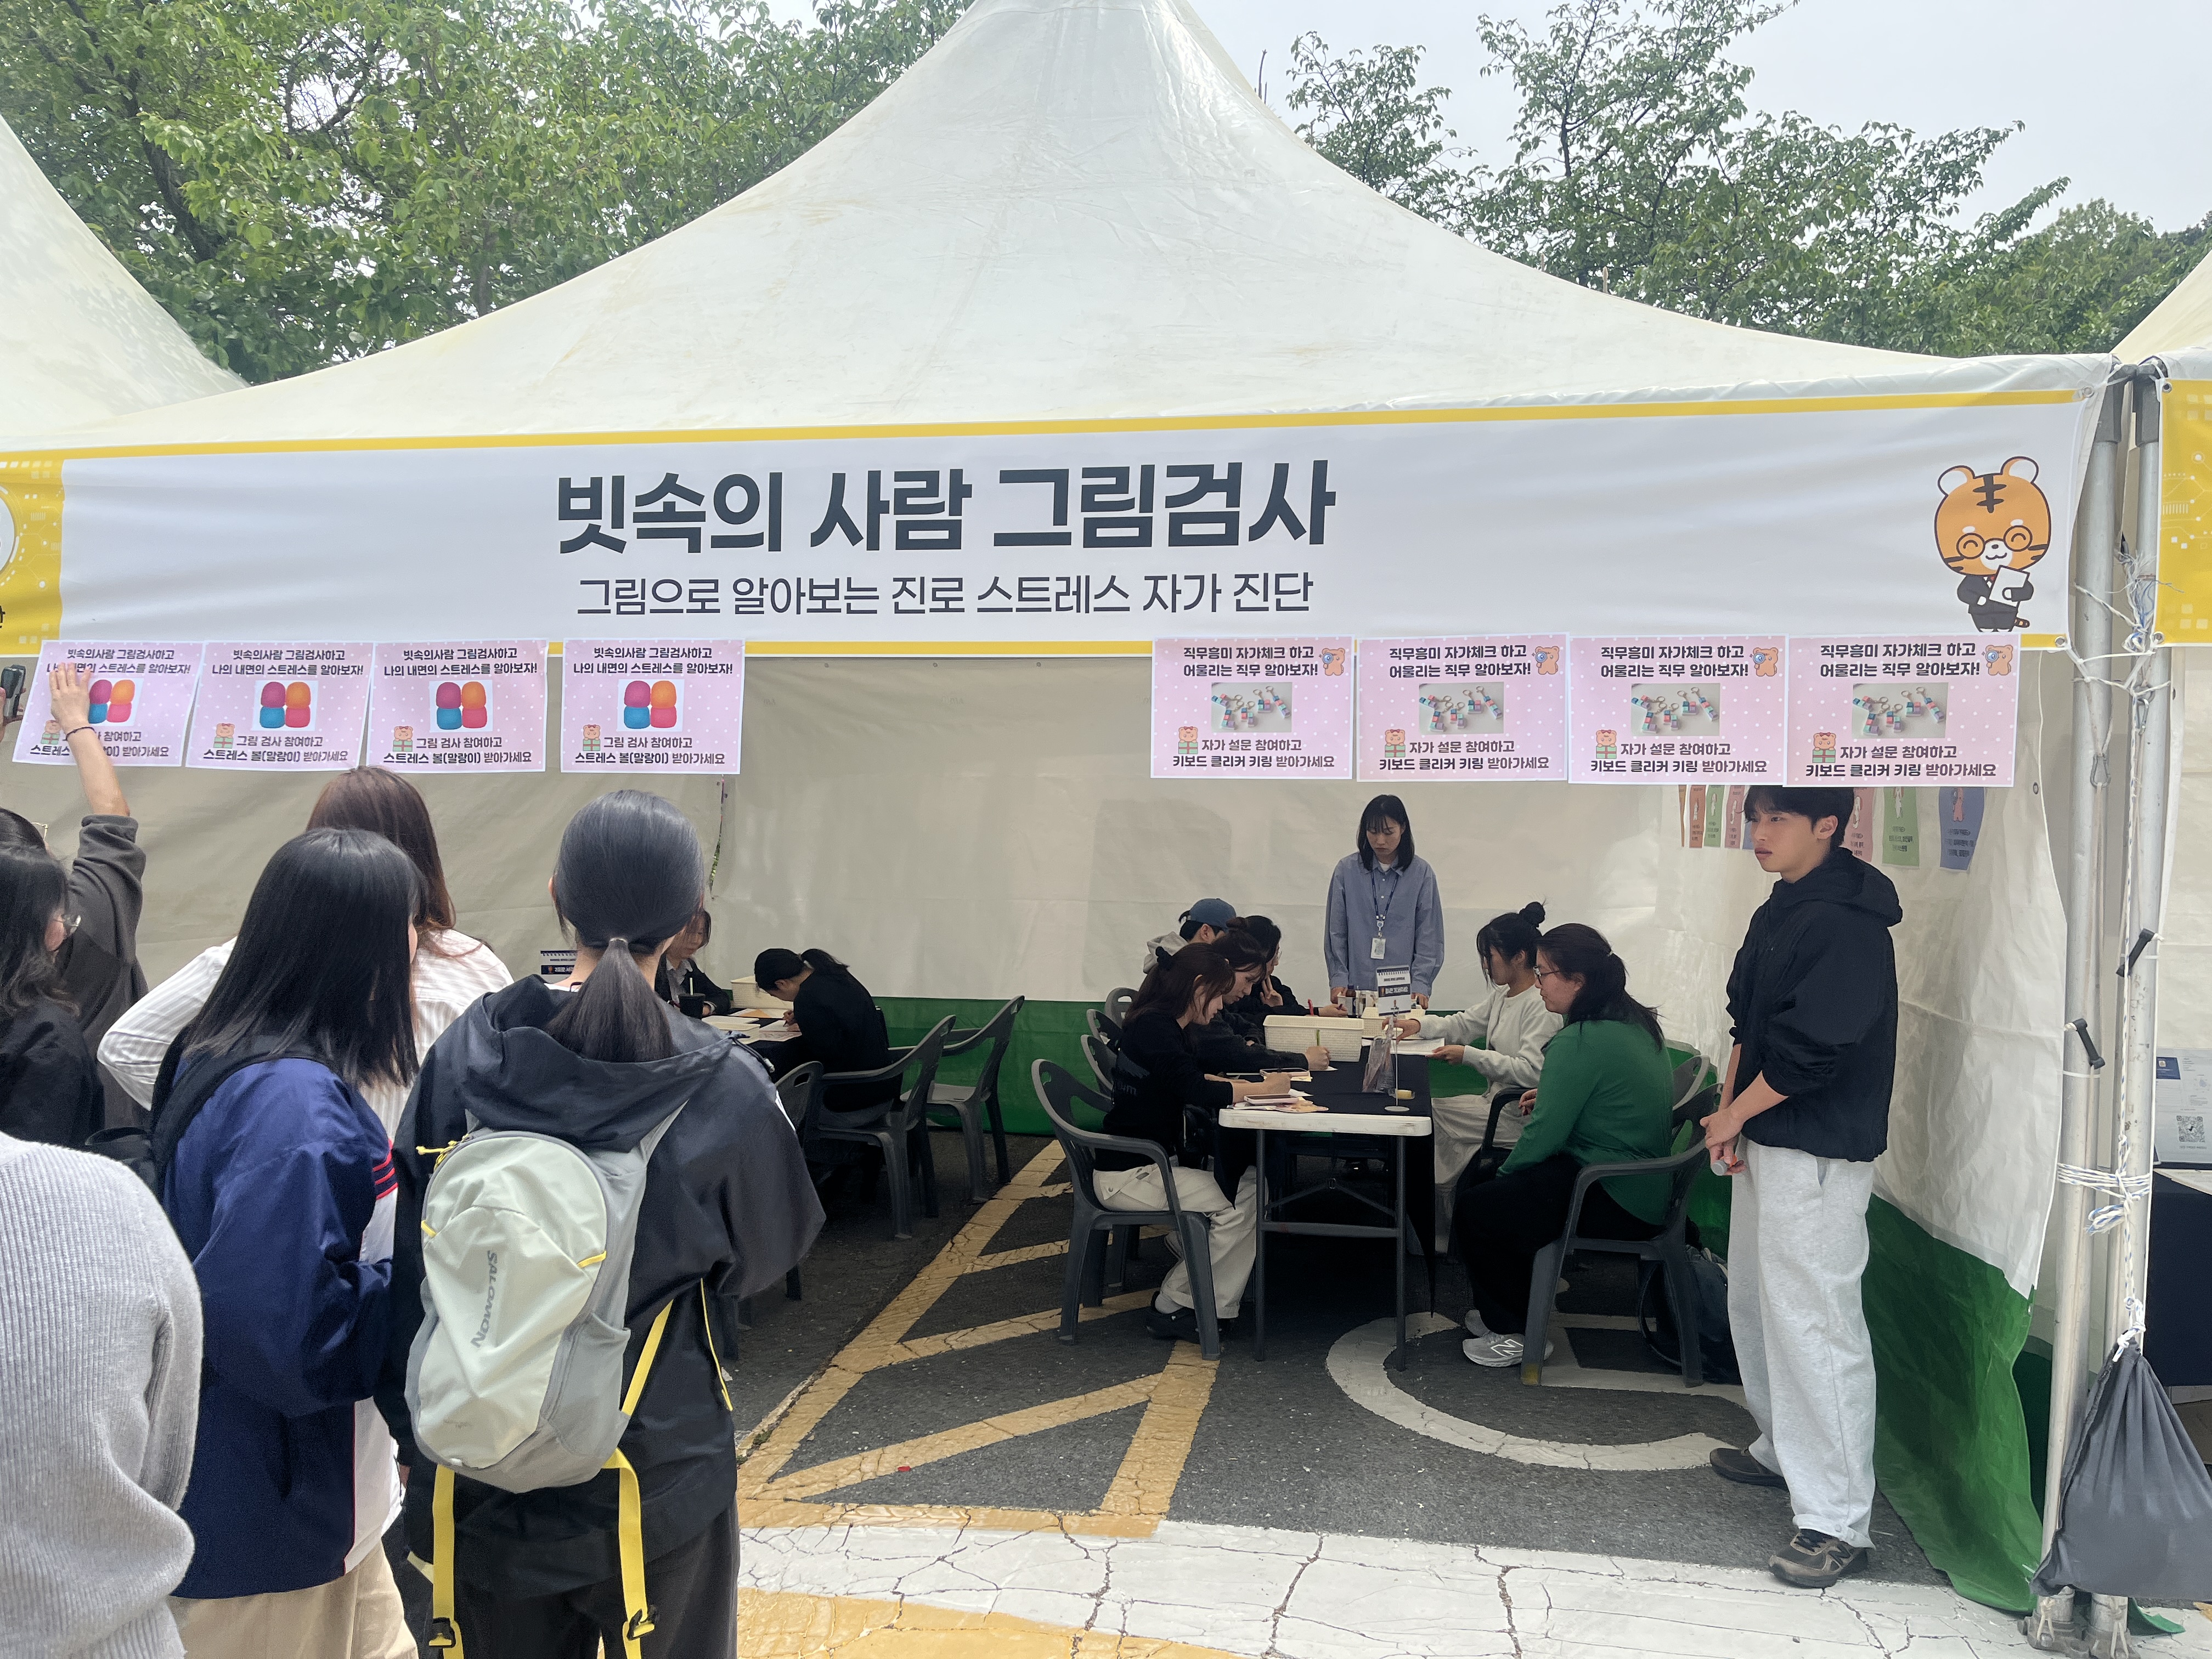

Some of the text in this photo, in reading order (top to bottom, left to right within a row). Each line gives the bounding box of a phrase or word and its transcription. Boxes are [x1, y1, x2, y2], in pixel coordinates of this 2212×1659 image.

[558, 459, 1336, 554] 빗속의 사람 그림검사
[577, 572, 1314, 615] 그림으로 알아보는 진로 스트레스 자가 진단
[67, 648, 175, 659] 빗속의사람 그림검사하고
[233, 650, 345, 661] 빗속의사람 그림검사하고
[403, 647, 517, 661] 빗속의사람 그림검사하고
[594, 647, 712, 658] 빗속의사람 그림검사하고
[1183, 646, 1314, 659] 직무흥미 자가체크 하고
[1389, 645, 1527, 661] 직무흥미 자가체크 하고
[1601, 645, 1745, 659] 직무흥미 자가체크 하고
[1820, 642, 1976, 658] 직무흥미 자가체크 하고
[98, 663, 146, 674] 스트레스를
[148, 663, 191, 674] 알아보자!
[212, 664, 364, 675] 나의 내면의 스트레스를 알아보자!
[384, 662, 537, 676] 나의 내면의 스트레스를 알아보자!
[573, 662, 733, 674] 나의 내면의 스트레스를 알아보자!
[1183, 663, 1318, 676] 어울리는 직무 알아보자!
[1390, 662, 1531, 678] 어울리는 직무 알아보자!
[1601, 663, 1748, 678] 어울리는 직무 알아보자!
[1820, 662, 1980, 678] 어울리는 직무 알아보자!
[104, 731, 142, 742] 참여하고
[236, 736, 323, 747] 그림 검사 참여하고
[416, 737, 503, 749] 그림 검사 참여하고
[603, 737, 693, 748] 그림 검사 참여하고
[30, 744, 70, 756] 스트레스
[122, 746, 169, 757] 받아가세요
[1201, 739, 1302, 751] 자가 설문 참여하고
[1409, 740, 1515, 754] 자가 설문 참여하고
[1621, 743, 1731, 755] 자가 설문 참여하고
[203, 749, 348, 763] 스트레스 볼(말랑이) 받아가세요
[383, 752, 532, 764] 스트레스 볼(말랑이) 받아가세요
[575, 752, 725, 764] 스트레스 볼(말랑이) 받아가세요
[1839, 746, 1957, 759] 자가 설문 참여하고
[1173, 755, 1335, 768] 키보드 클리커 키링 받아가세요
[1379, 757, 1549, 770] 키보드 클리커 키링 받아가세요
[1590, 760, 1767, 772] 키보드 클리커 키링 받아가세요
[1805, 763, 1996, 777] 키보드 클리커 키링 받아가세요
[470, 1250, 498, 1348] SALOMON
